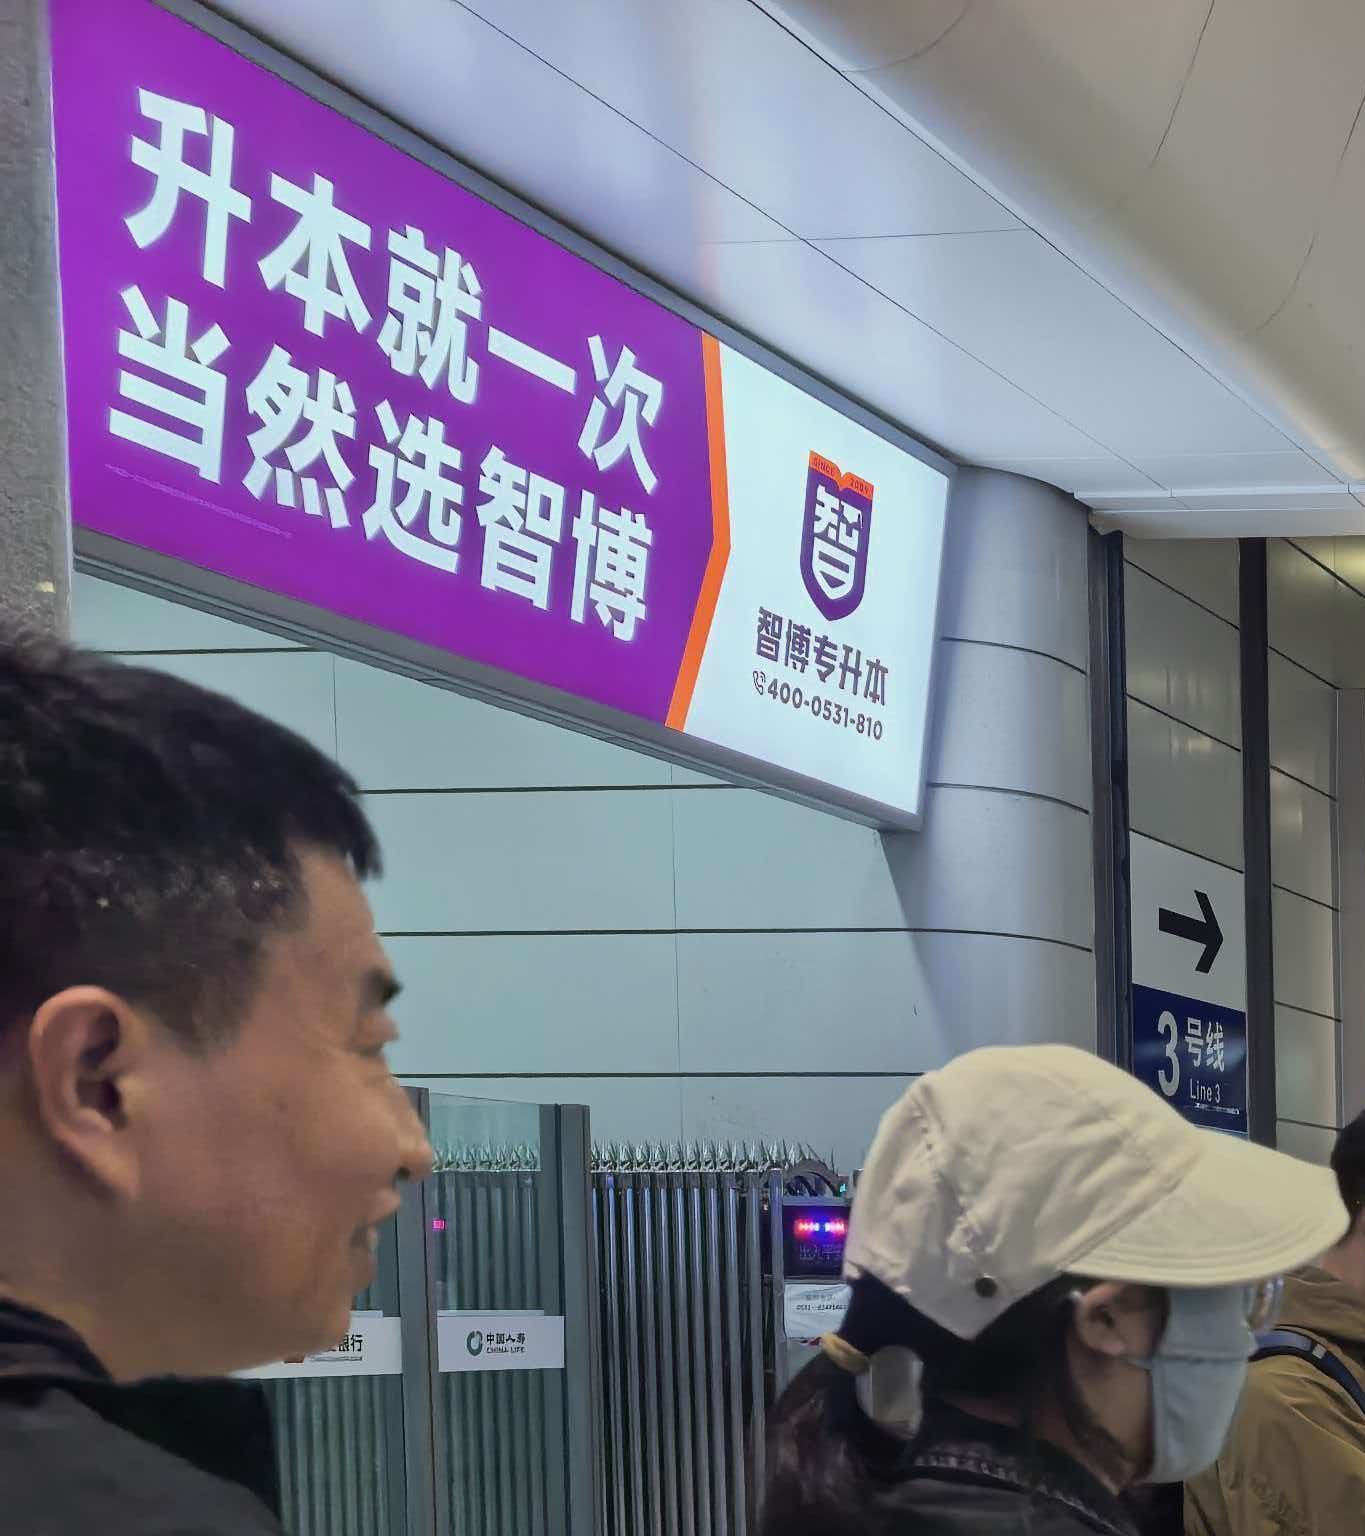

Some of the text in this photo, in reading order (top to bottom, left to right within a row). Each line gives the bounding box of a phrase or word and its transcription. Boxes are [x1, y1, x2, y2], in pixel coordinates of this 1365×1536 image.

[124, 87, 663, 496] 升本就一次
[110, 285, 652, 641] 当然选智博
[756, 606, 888, 706] 智博专升本
[767, 677, 883, 740] 400-0531-810
[1190, 1078, 1221, 1103] Line 3
